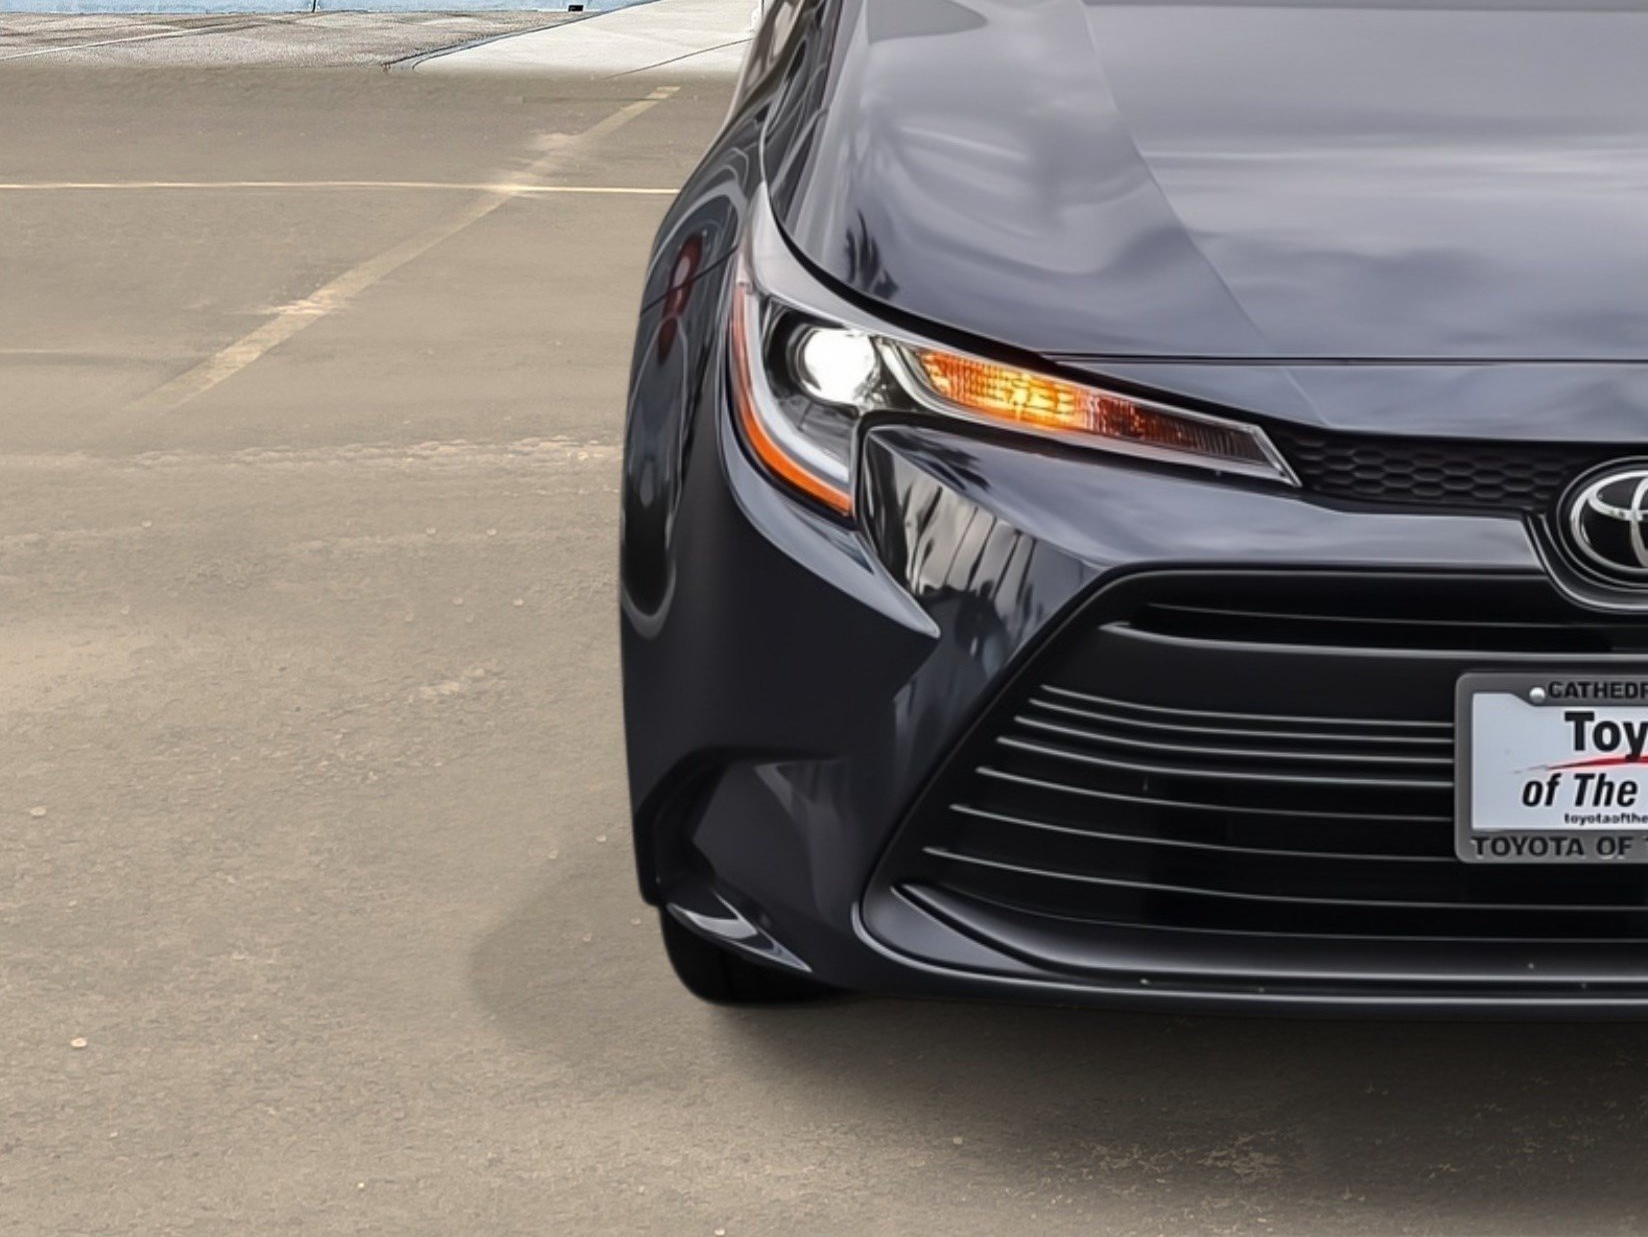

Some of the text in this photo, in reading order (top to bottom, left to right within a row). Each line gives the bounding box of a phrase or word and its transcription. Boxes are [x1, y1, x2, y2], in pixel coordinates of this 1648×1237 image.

[1522, 772, 1561, 807] of
[1573, 773, 1638, 807] The
[1472, 836, 1585, 858] TOYOTA
[1596, 836, 1633, 858] OF
